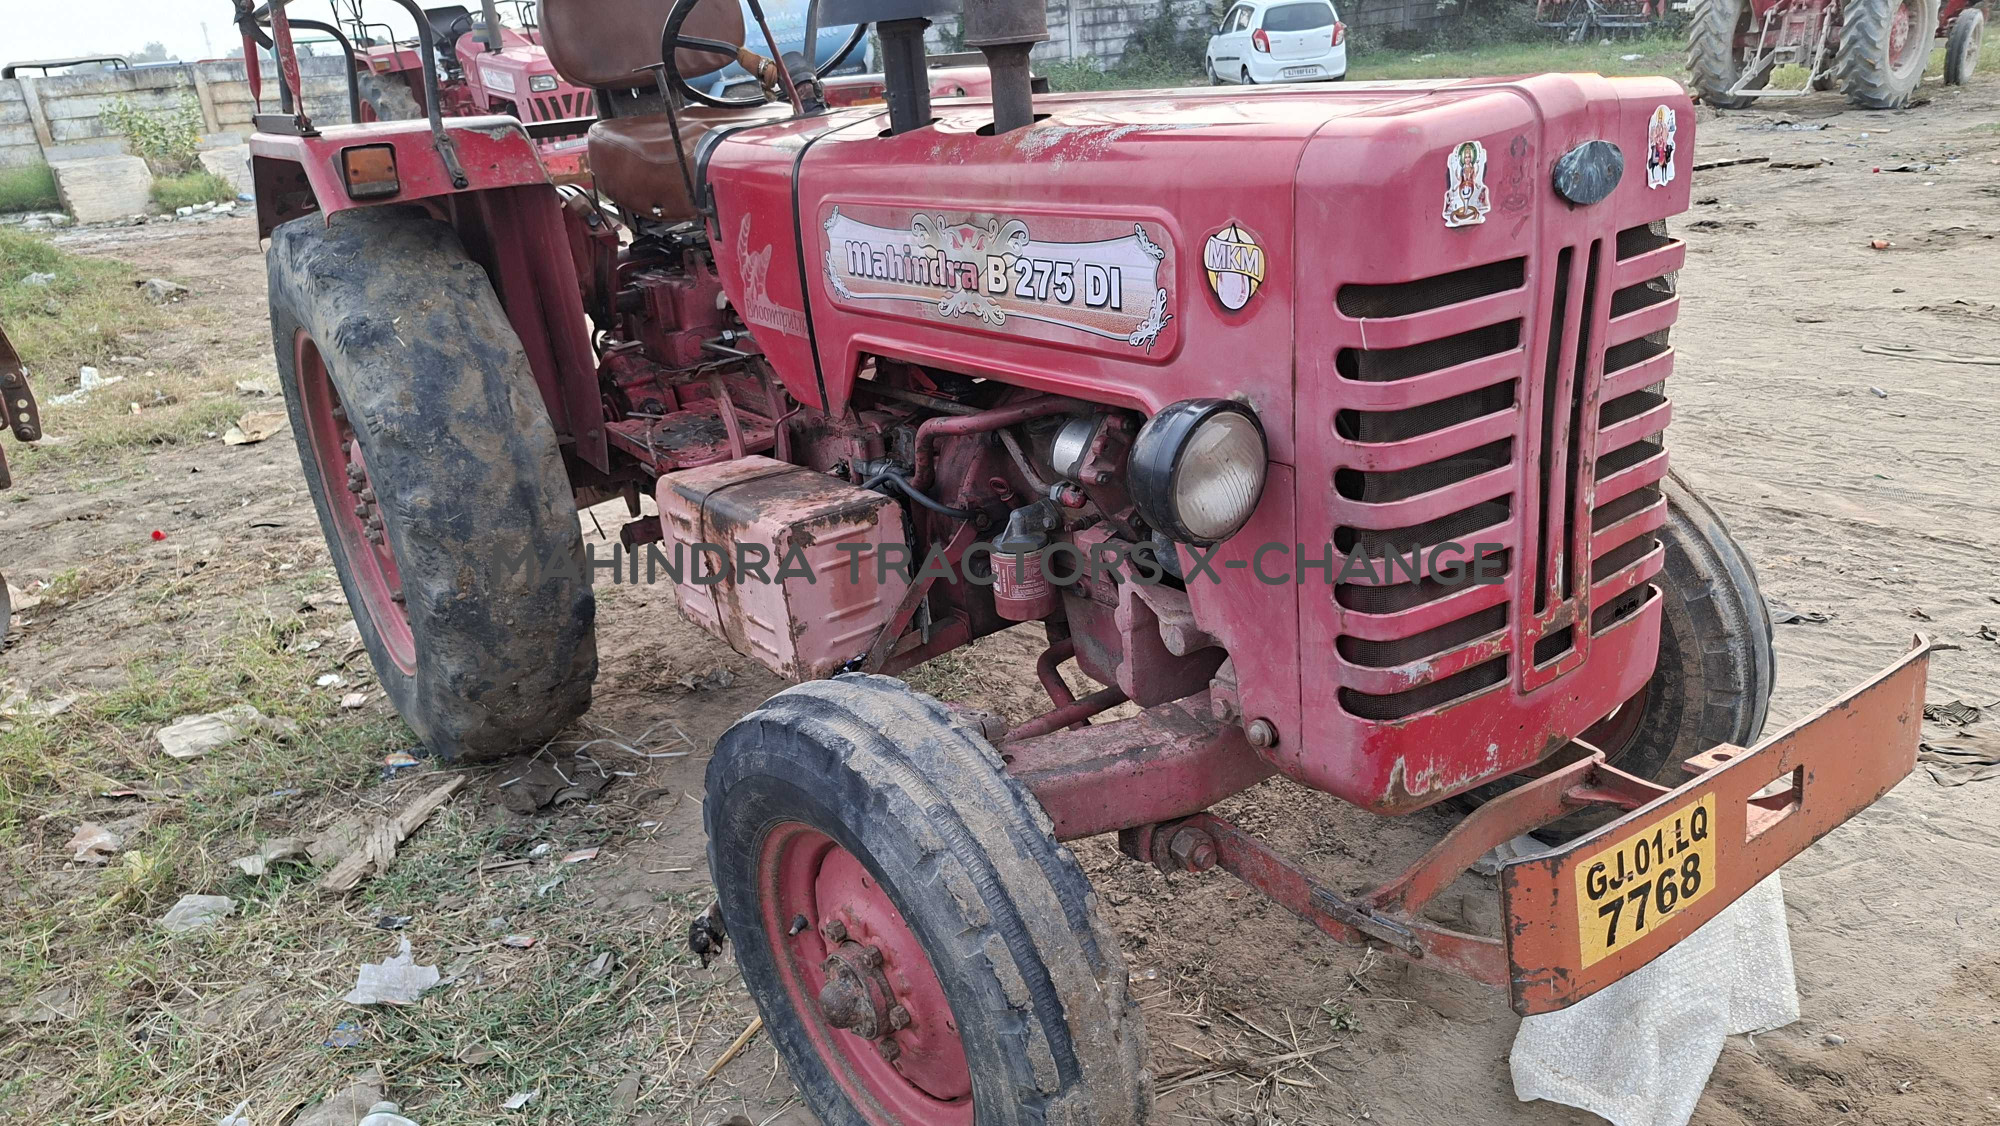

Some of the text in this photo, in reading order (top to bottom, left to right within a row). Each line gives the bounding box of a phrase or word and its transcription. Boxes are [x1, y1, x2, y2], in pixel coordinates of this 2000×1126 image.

[845, 240, 1122, 309] Mahindra B 275 DI
[1207, 238, 1260, 278] MKM
[1598, 852, 1702, 948] 7768
